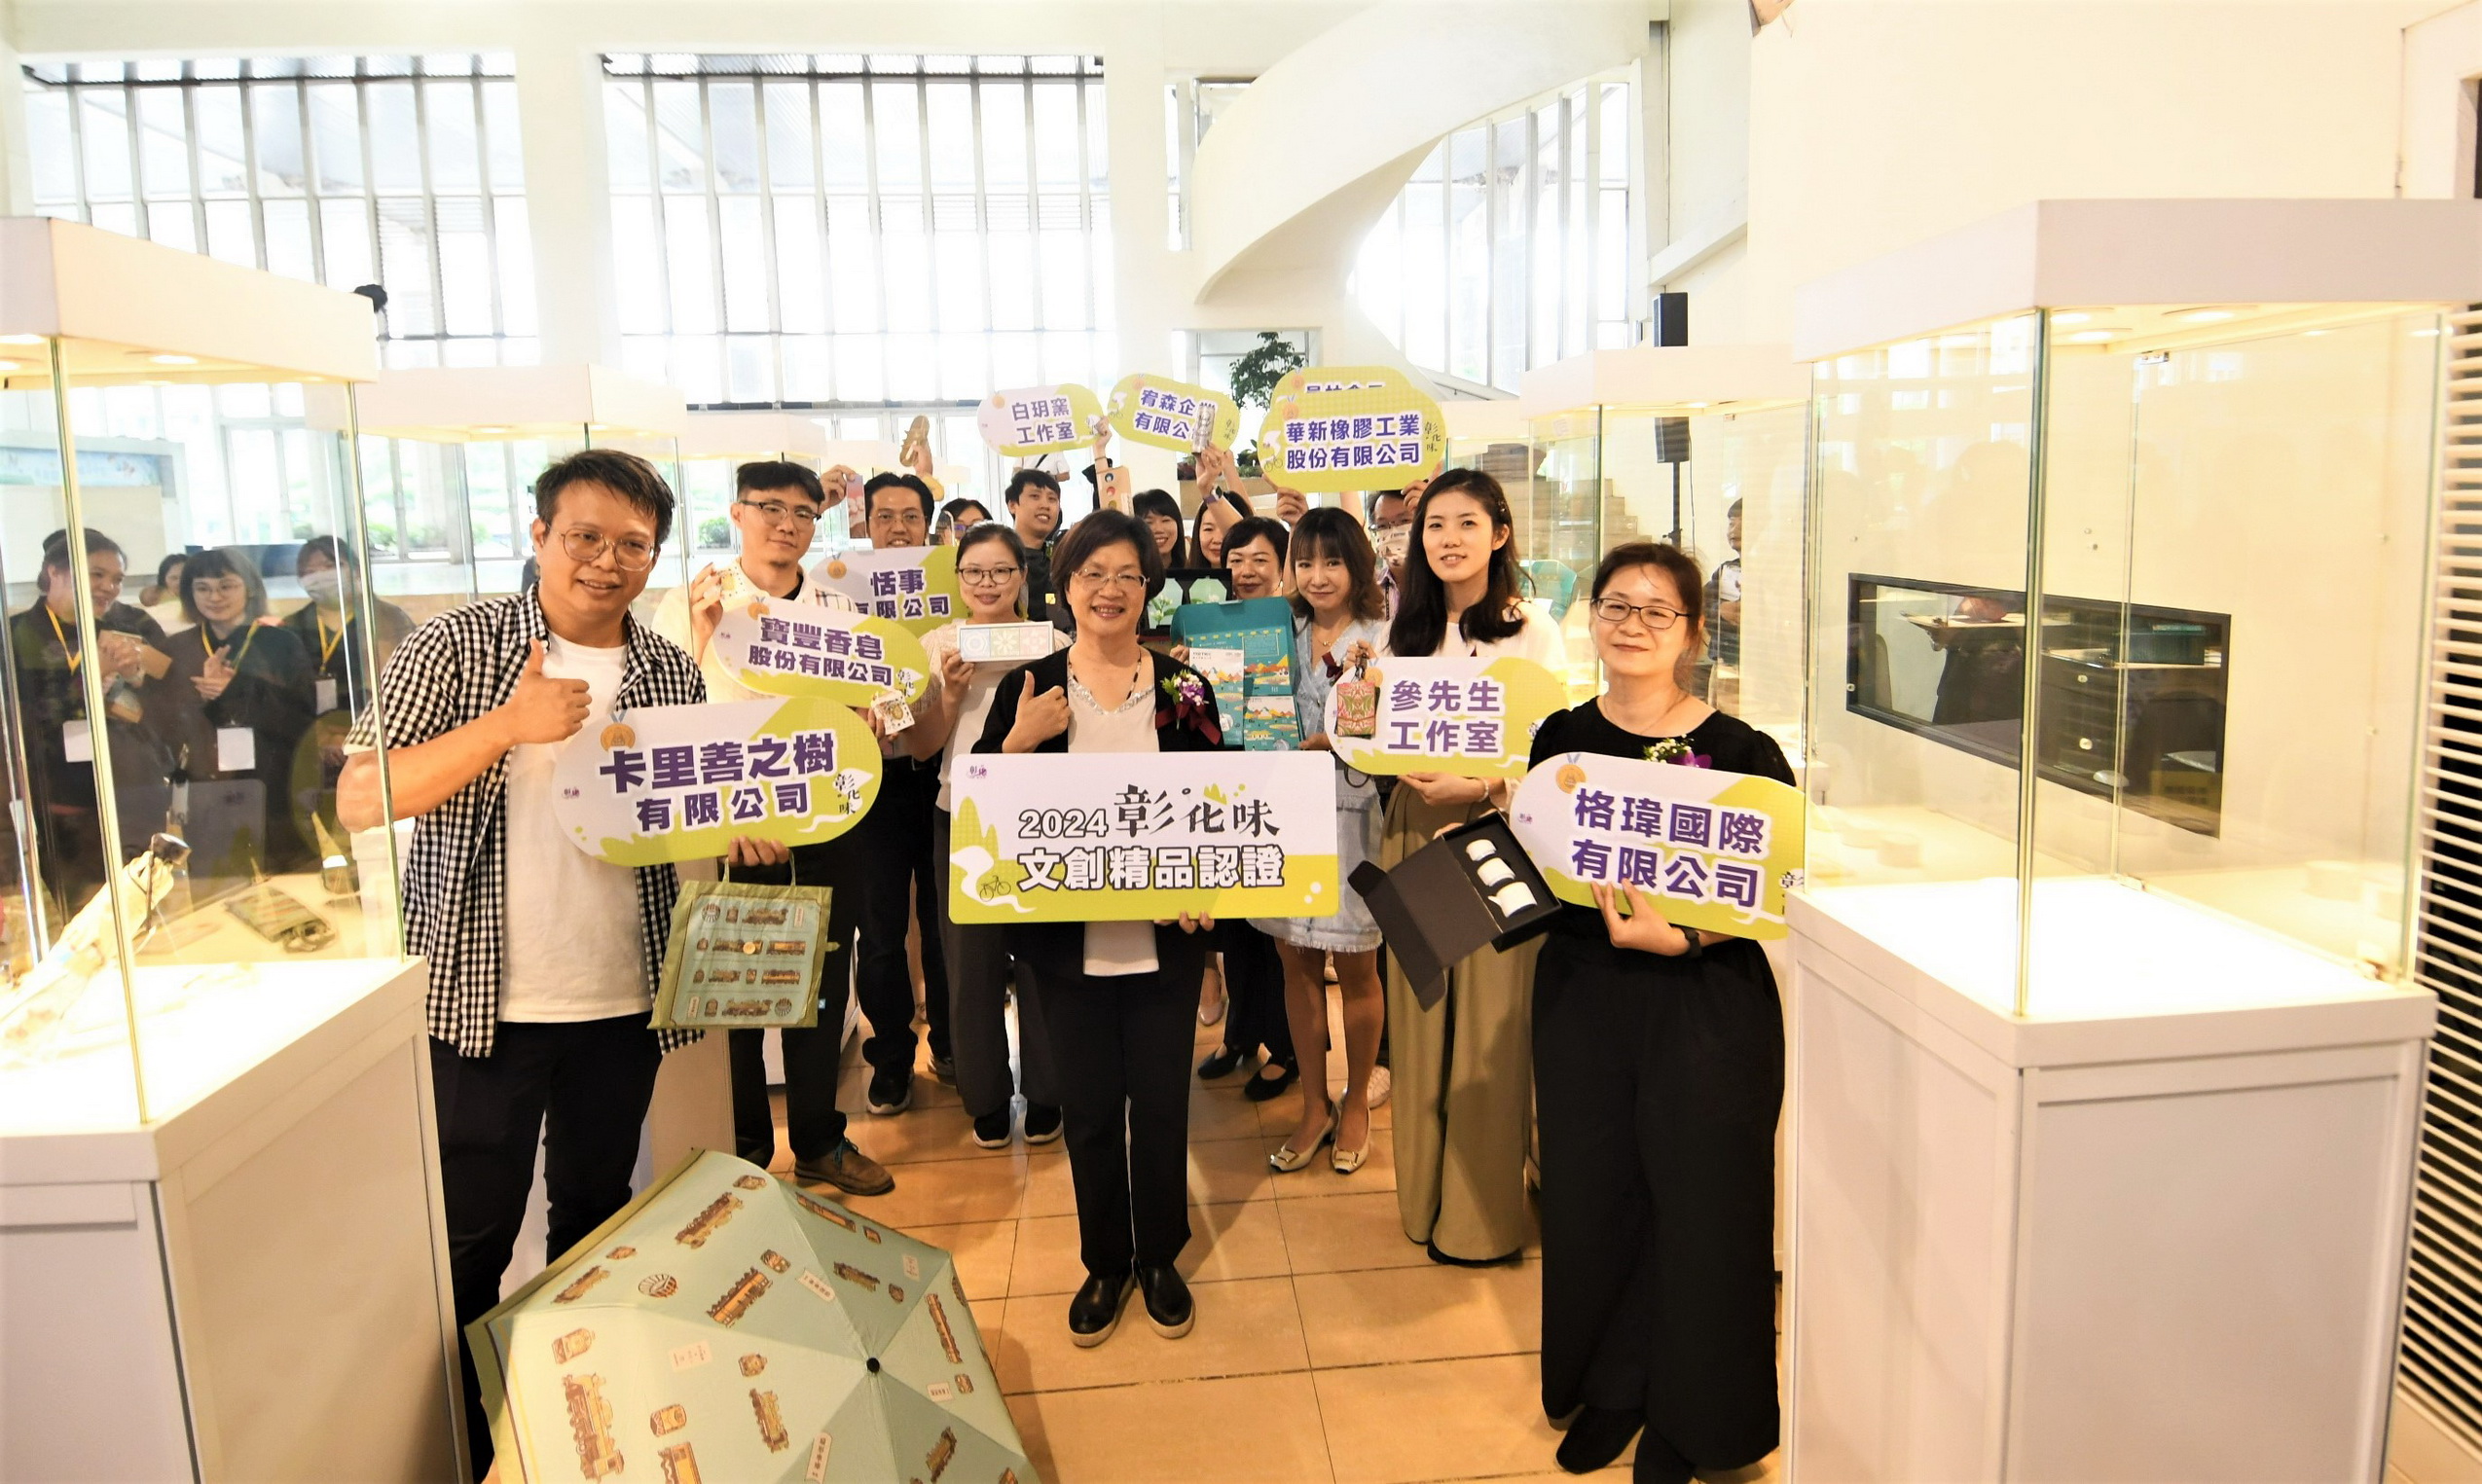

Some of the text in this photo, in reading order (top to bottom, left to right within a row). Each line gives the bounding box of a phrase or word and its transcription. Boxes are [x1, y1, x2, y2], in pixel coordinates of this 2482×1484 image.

[1141, 390, 1215, 416] 宥森企
[1016, 422, 1075, 444] 工作室
[1135, 412, 1196, 440] 有限公
[1286, 414, 1420, 443] 華新橡膠工業
[1287, 442, 1419, 470] 股份有限公司
[870, 569, 924, 597] 恬事
[759, 617, 883, 660] 寶豐香皂
[748, 644, 893, 686] 股份有限公司
[1391, 680, 1500, 711] 參先生
[1388, 720, 1499, 752] 工作室
[600, 733, 834, 793] 卡里善之樹
[636, 782, 808, 832] 有限公司
[1575, 788, 1765, 854] 格瑋國際
[1017, 844, 1285, 892] 文創精品認證
[1571, 839, 1758, 908] 有限公司
